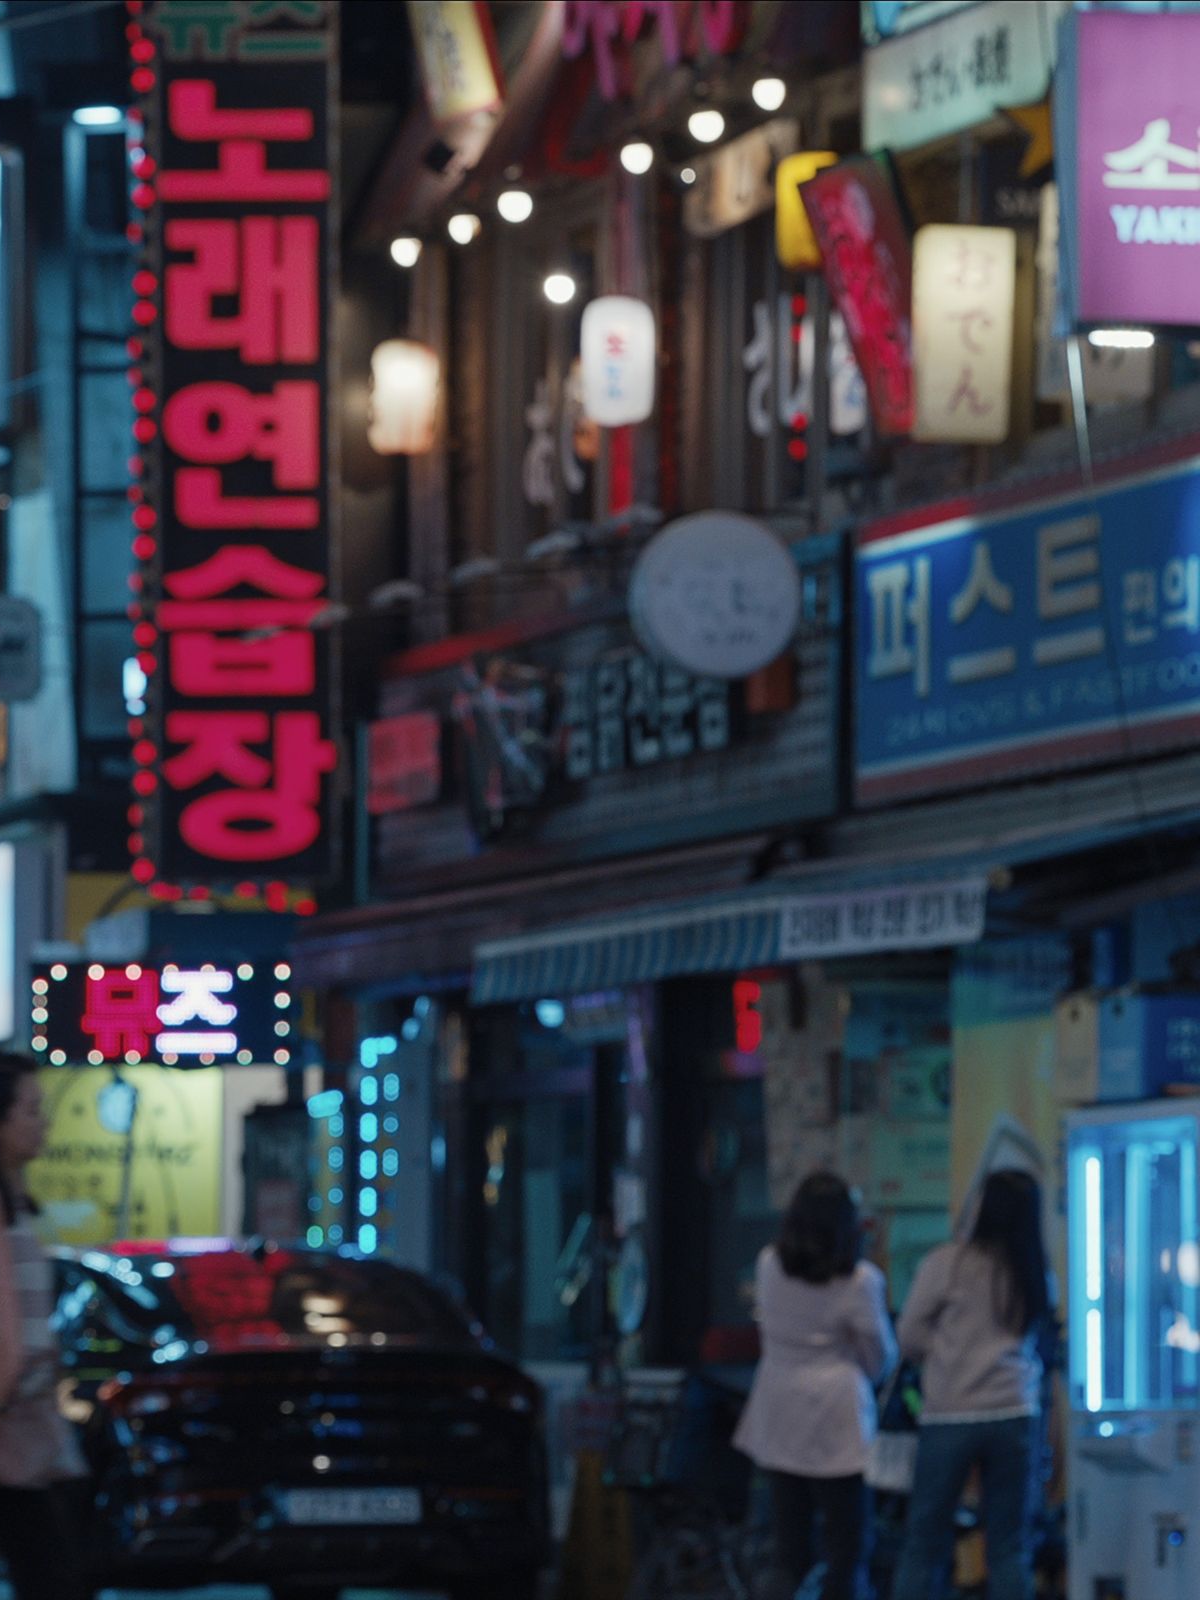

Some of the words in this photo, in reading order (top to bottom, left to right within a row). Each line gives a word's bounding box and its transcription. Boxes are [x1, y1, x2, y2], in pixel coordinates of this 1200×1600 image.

[1102, 117, 1200, 190] 소
[157, 79, 337, 862] 노래연습장
[868, 514, 1105, 700] 퍼스트
[1123, 553, 1200, 645] 편의
[82, 969, 237, 1057] 뮤즈
